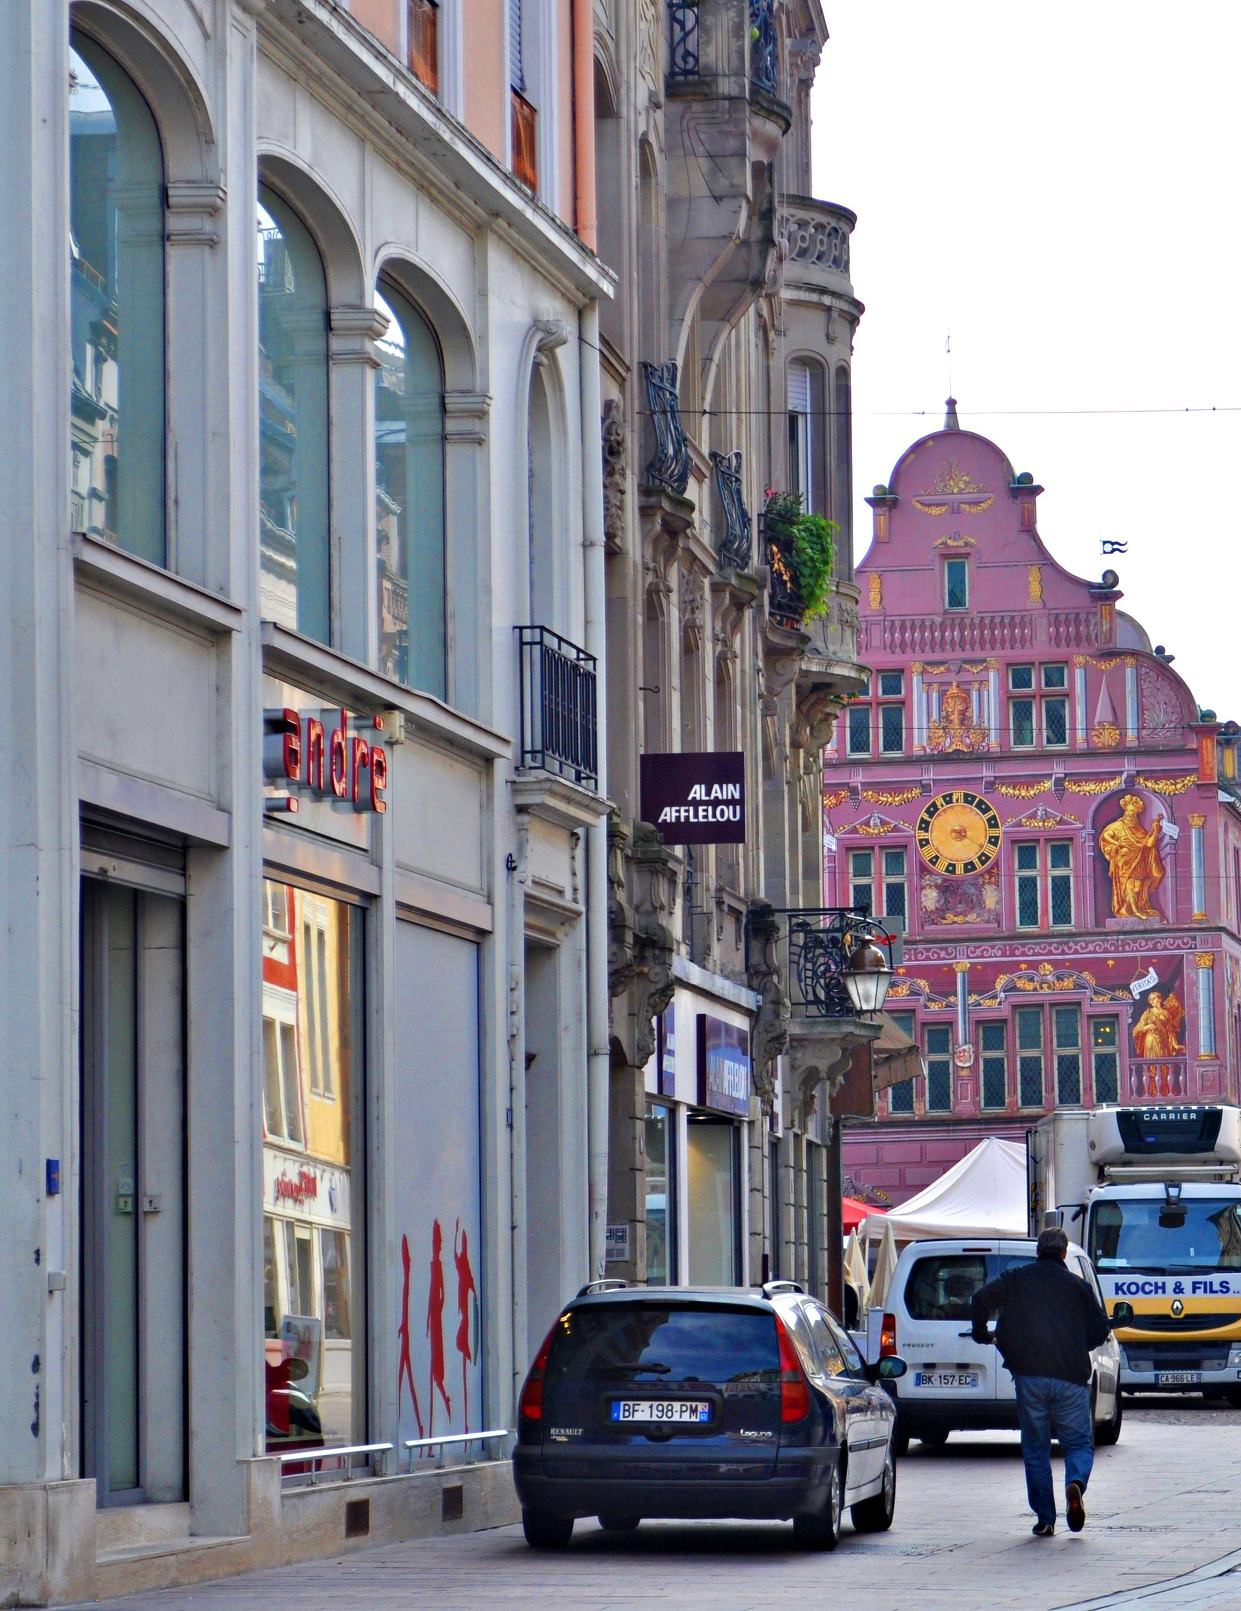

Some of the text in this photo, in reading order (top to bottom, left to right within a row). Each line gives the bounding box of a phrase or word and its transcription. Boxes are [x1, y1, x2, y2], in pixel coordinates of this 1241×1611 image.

[687, 784, 740, 800] ALAIN
[658, 805, 741, 823] AFFLELOU
[1114, 1281, 1166, 1295] KOCH
[1172, 1281, 1185, 1294] &
[1192, 1280, 1231, 1294] FILS
[550, 1428, 583, 1436] RENAULT
